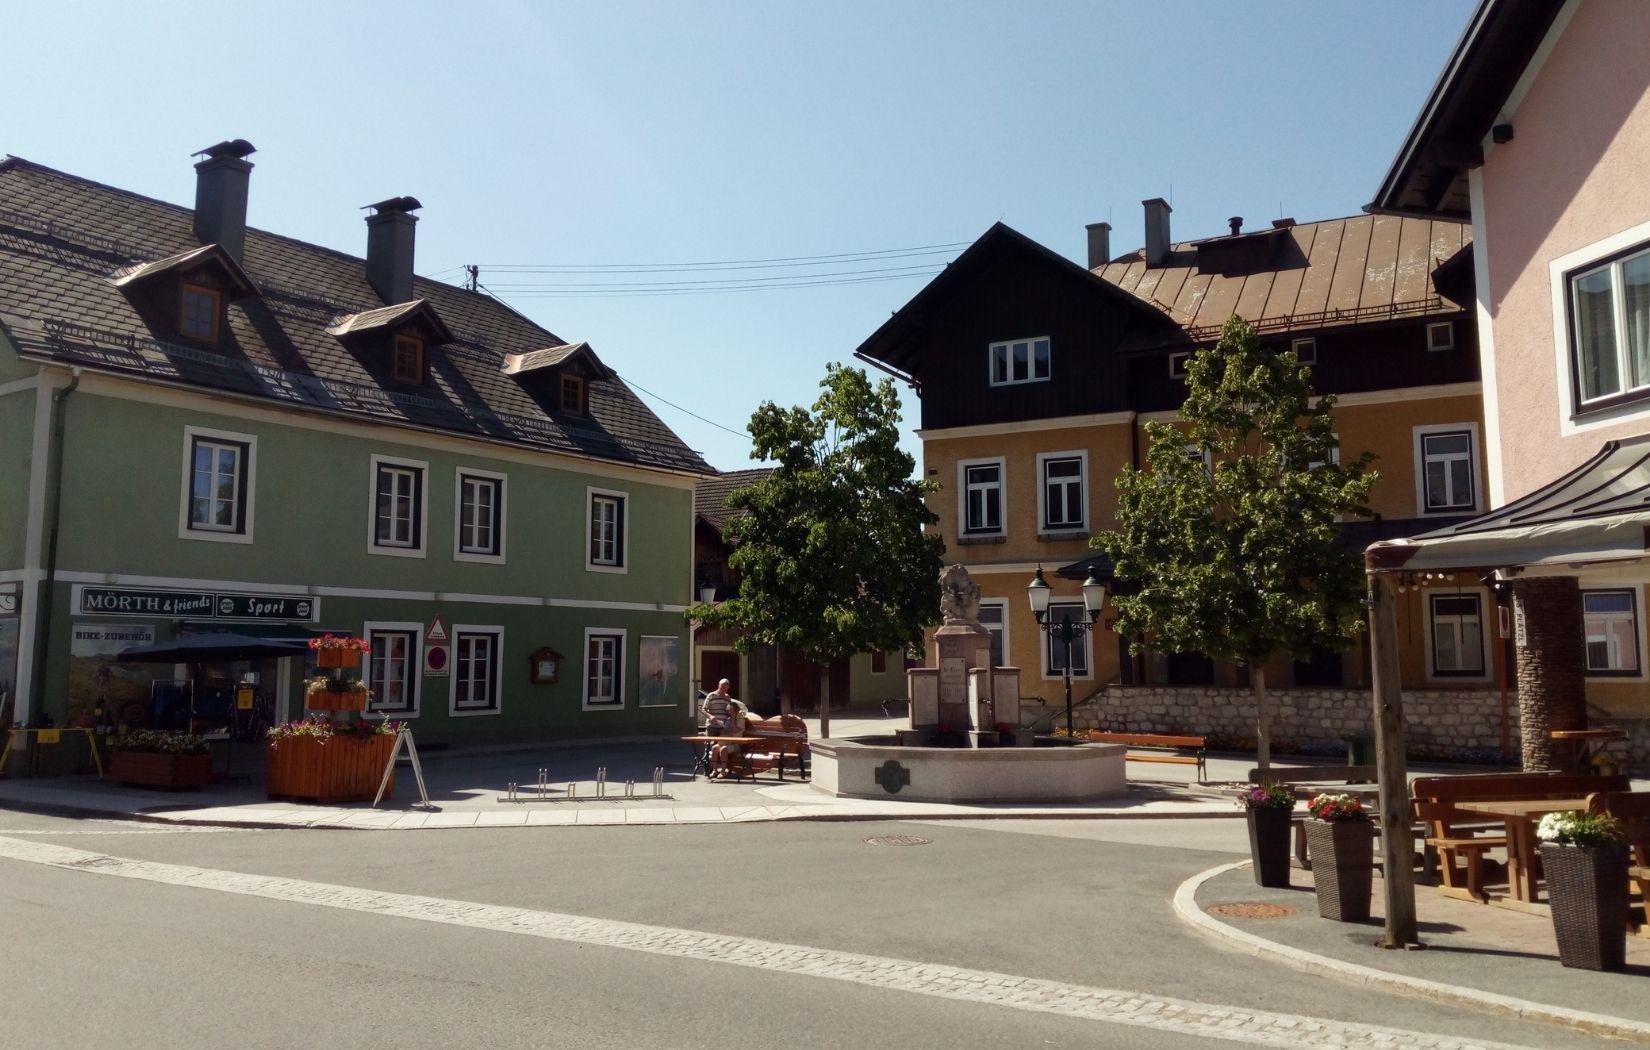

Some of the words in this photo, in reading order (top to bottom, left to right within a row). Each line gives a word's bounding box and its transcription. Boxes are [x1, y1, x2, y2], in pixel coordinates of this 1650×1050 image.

[87, 592, 161, 611] MÖRTH
[163, 599, 171, 611] &
[174, 596, 210, 614] friends
[247, 598, 285, 616] Sport
[75, 631, 152, 641] BIKE-ZUBEHÖR
